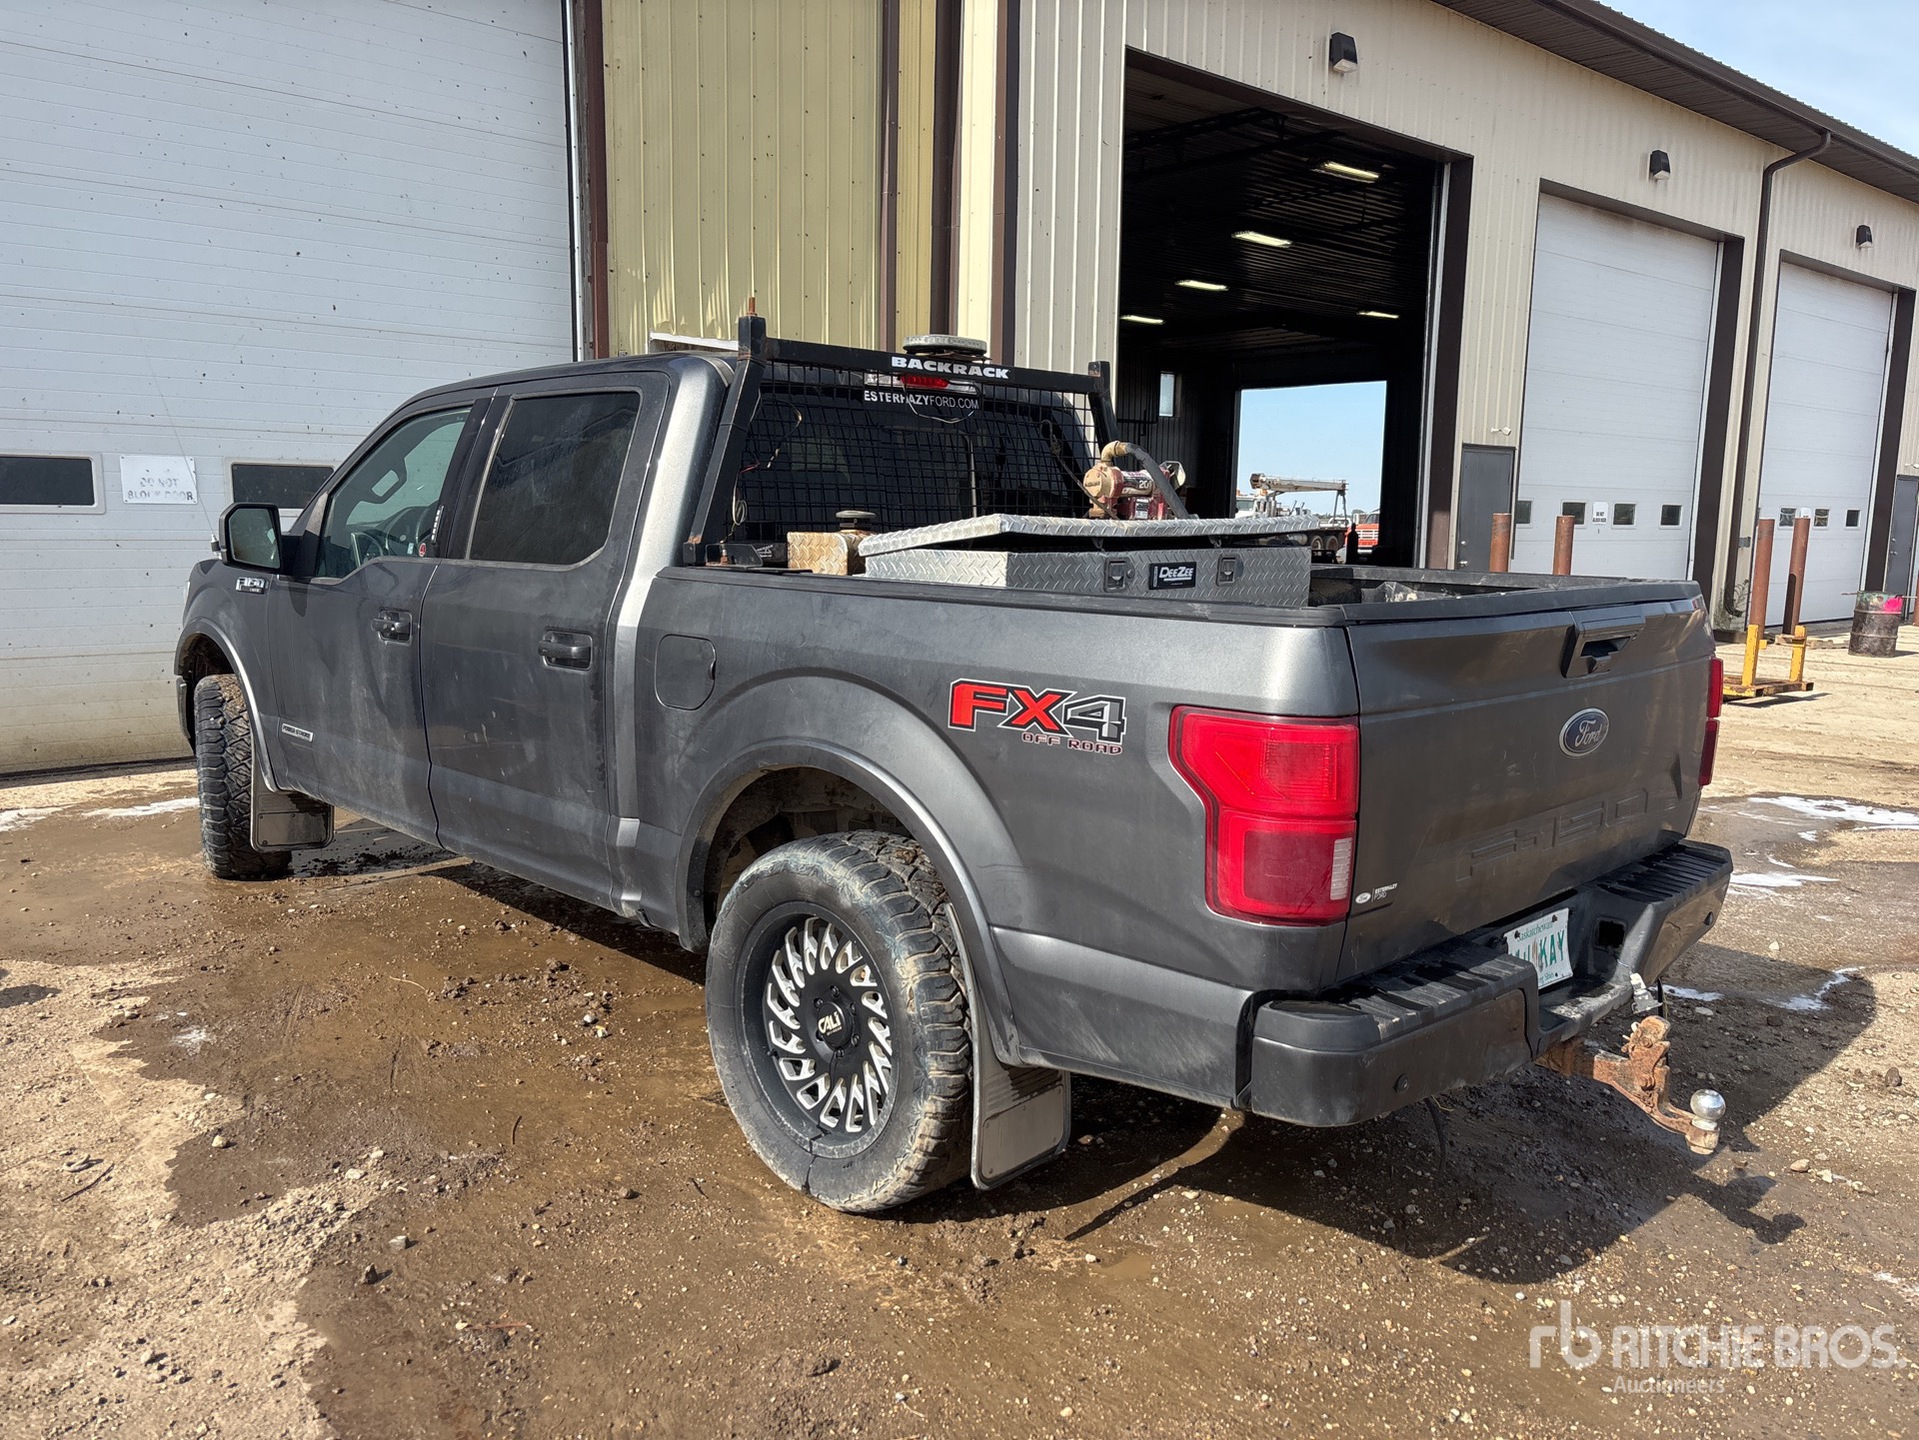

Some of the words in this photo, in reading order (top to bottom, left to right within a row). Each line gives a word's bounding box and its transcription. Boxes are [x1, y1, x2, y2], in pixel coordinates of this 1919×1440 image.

[891, 356, 1010, 380] BACKRACK
[864, 390, 980, 410] ESTERHAZYFORD.COM
[948, 678, 1127, 745] FX4
[1022, 732, 1061, 747] OFF
[1068, 738, 1123, 756] ROAD
[1574, 719, 1603, 748] Ford
